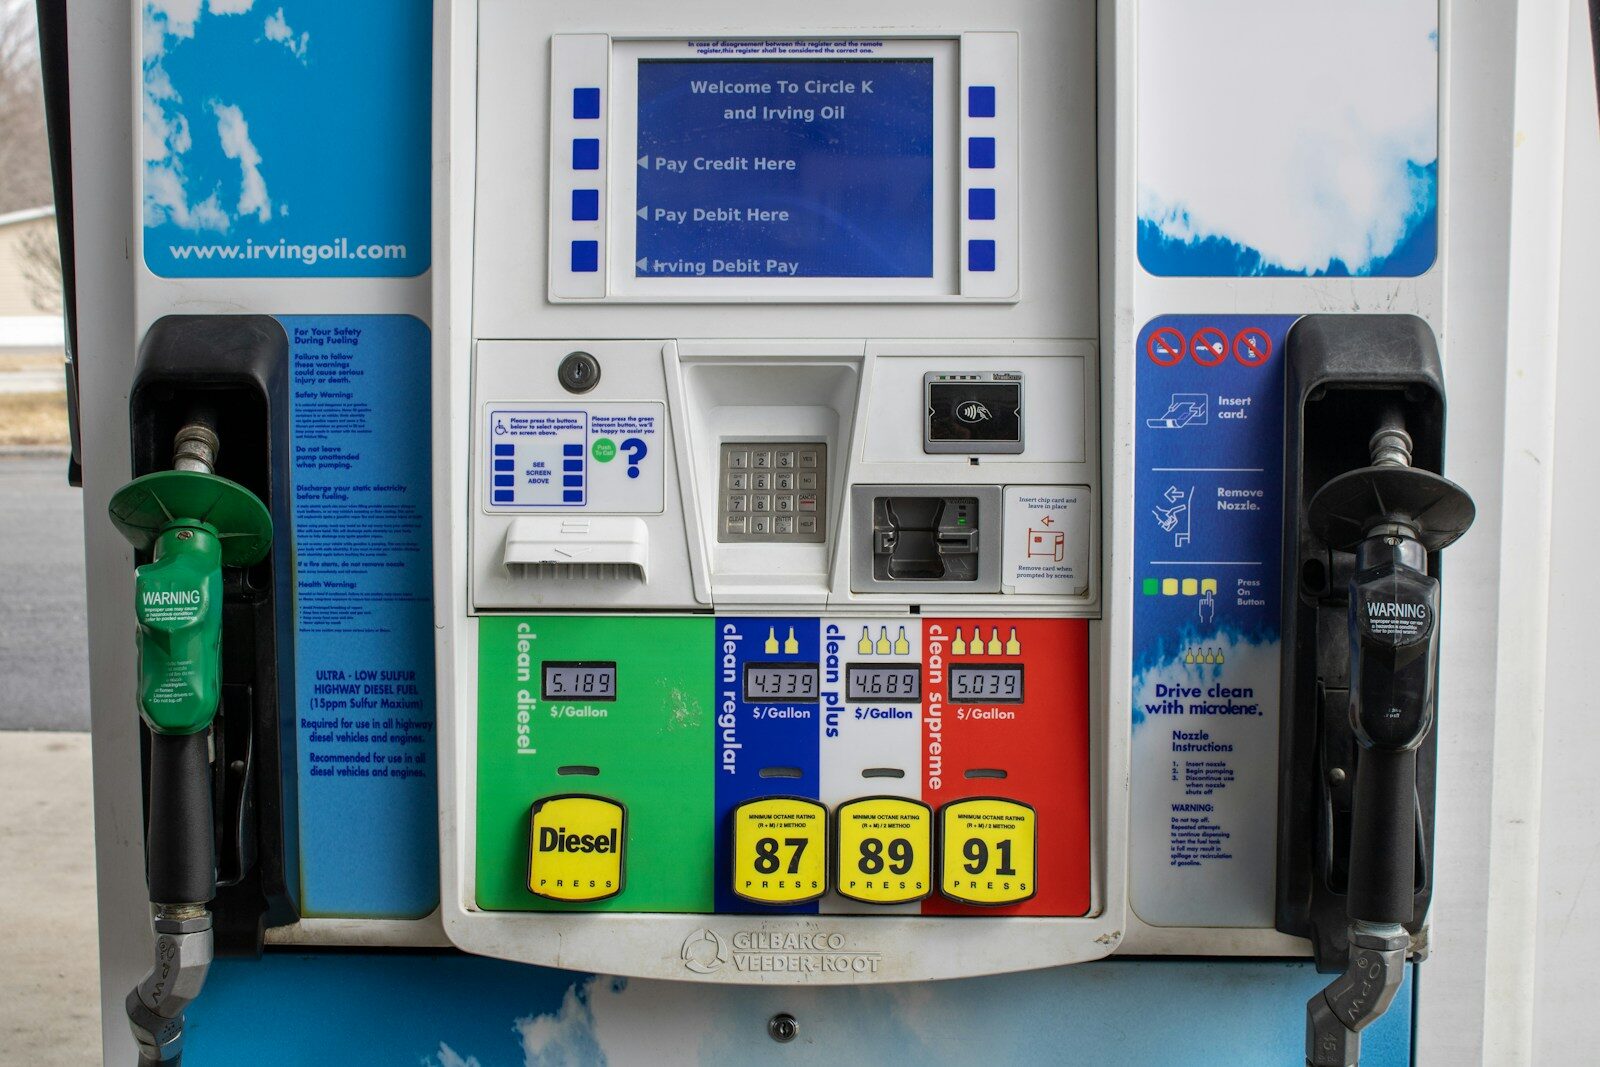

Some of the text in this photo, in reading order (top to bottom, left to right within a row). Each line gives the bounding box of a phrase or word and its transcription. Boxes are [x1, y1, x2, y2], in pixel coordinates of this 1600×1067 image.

[690, 80, 874, 94] Welcome To Circle K
[723, 106, 844, 123] and Irving Oil
[655, 157, 796, 174] Pay Credit Here
[655, 208, 789, 225] Pay Debit Here
[169, 238, 406, 265] www.irvingoil.com
[711, 259, 760, 273] Debit
[766, 259, 799, 276] Pay
[334, 328, 361, 337] Safety
[294, 337, 358, 345] During Fueling
[1218, 396, 1252, 406] Insert
[1218, 408, 1247, 419] card.
[296, 485, 332, 493] Discharge
[373, 485, 407, 493] electricity
[1217, 487, 1264, 497] Remove
[1217, 501, 1260, 511] Nozzle.
[323, 581, 357, 589] Warning:
[143, 590, 200, 606] WARNING
[1237, 598, 1265, 606] Button
[1367, 602, 1426, 619] WARNING
[316, 670, 416, 681] ULTRA LOW SULFUR
[820, 624, 846, 738] clean plus
[314, 684, 419, 694] HIGHWAY DIESEL FUEL
[517, 622, 537, 754] clean diesel
[552, 673, 610, 693] 5.189
[755, 674, 813, 694] 4.339
[856, 674, 913, 694] 4.689
[957, 675, 1016, 694] 5.039
[1156, 683, 1254, 698] Drive clean
[310, 698, 347, 711] (15ppm
[350, 698, 378, 708] Sulfur
[718, 623, 743, 775] clean regular
[550, 705, 608, 718] $/Gallon
[752, 707, 811, 719] $/Gallon
[854, 707, 912, 720] $/Gallon
[924, 624, 949, 790] clean supreme
[1145, 700, 1184, 714] with
[957, 708, 1015, 721] $/Gallon
[301, 718, 433, 731] Required for use in all highway
[309, 732, 425, 745] diesel vehicles and engines.
[1172, 730, 1209, 740] Nozzle
[1172, 742, 1233, 752] Instructions
[310, 752, 426, 763] Recommended for use in all
[310, 766, 426, 779] diesel vehicles and engines.
[1171, 804, 1214, 812] WARNING:
[539, 827, 617, 854] Diesel
[753, 837, 809, 875] 87
[857, 837, 914, 875] 89
[962, 837, 1016, 876] 91
[732, 931, 846, 950] GILBARCO
[732, 954, 882, 972] VEEDER-ROOT
